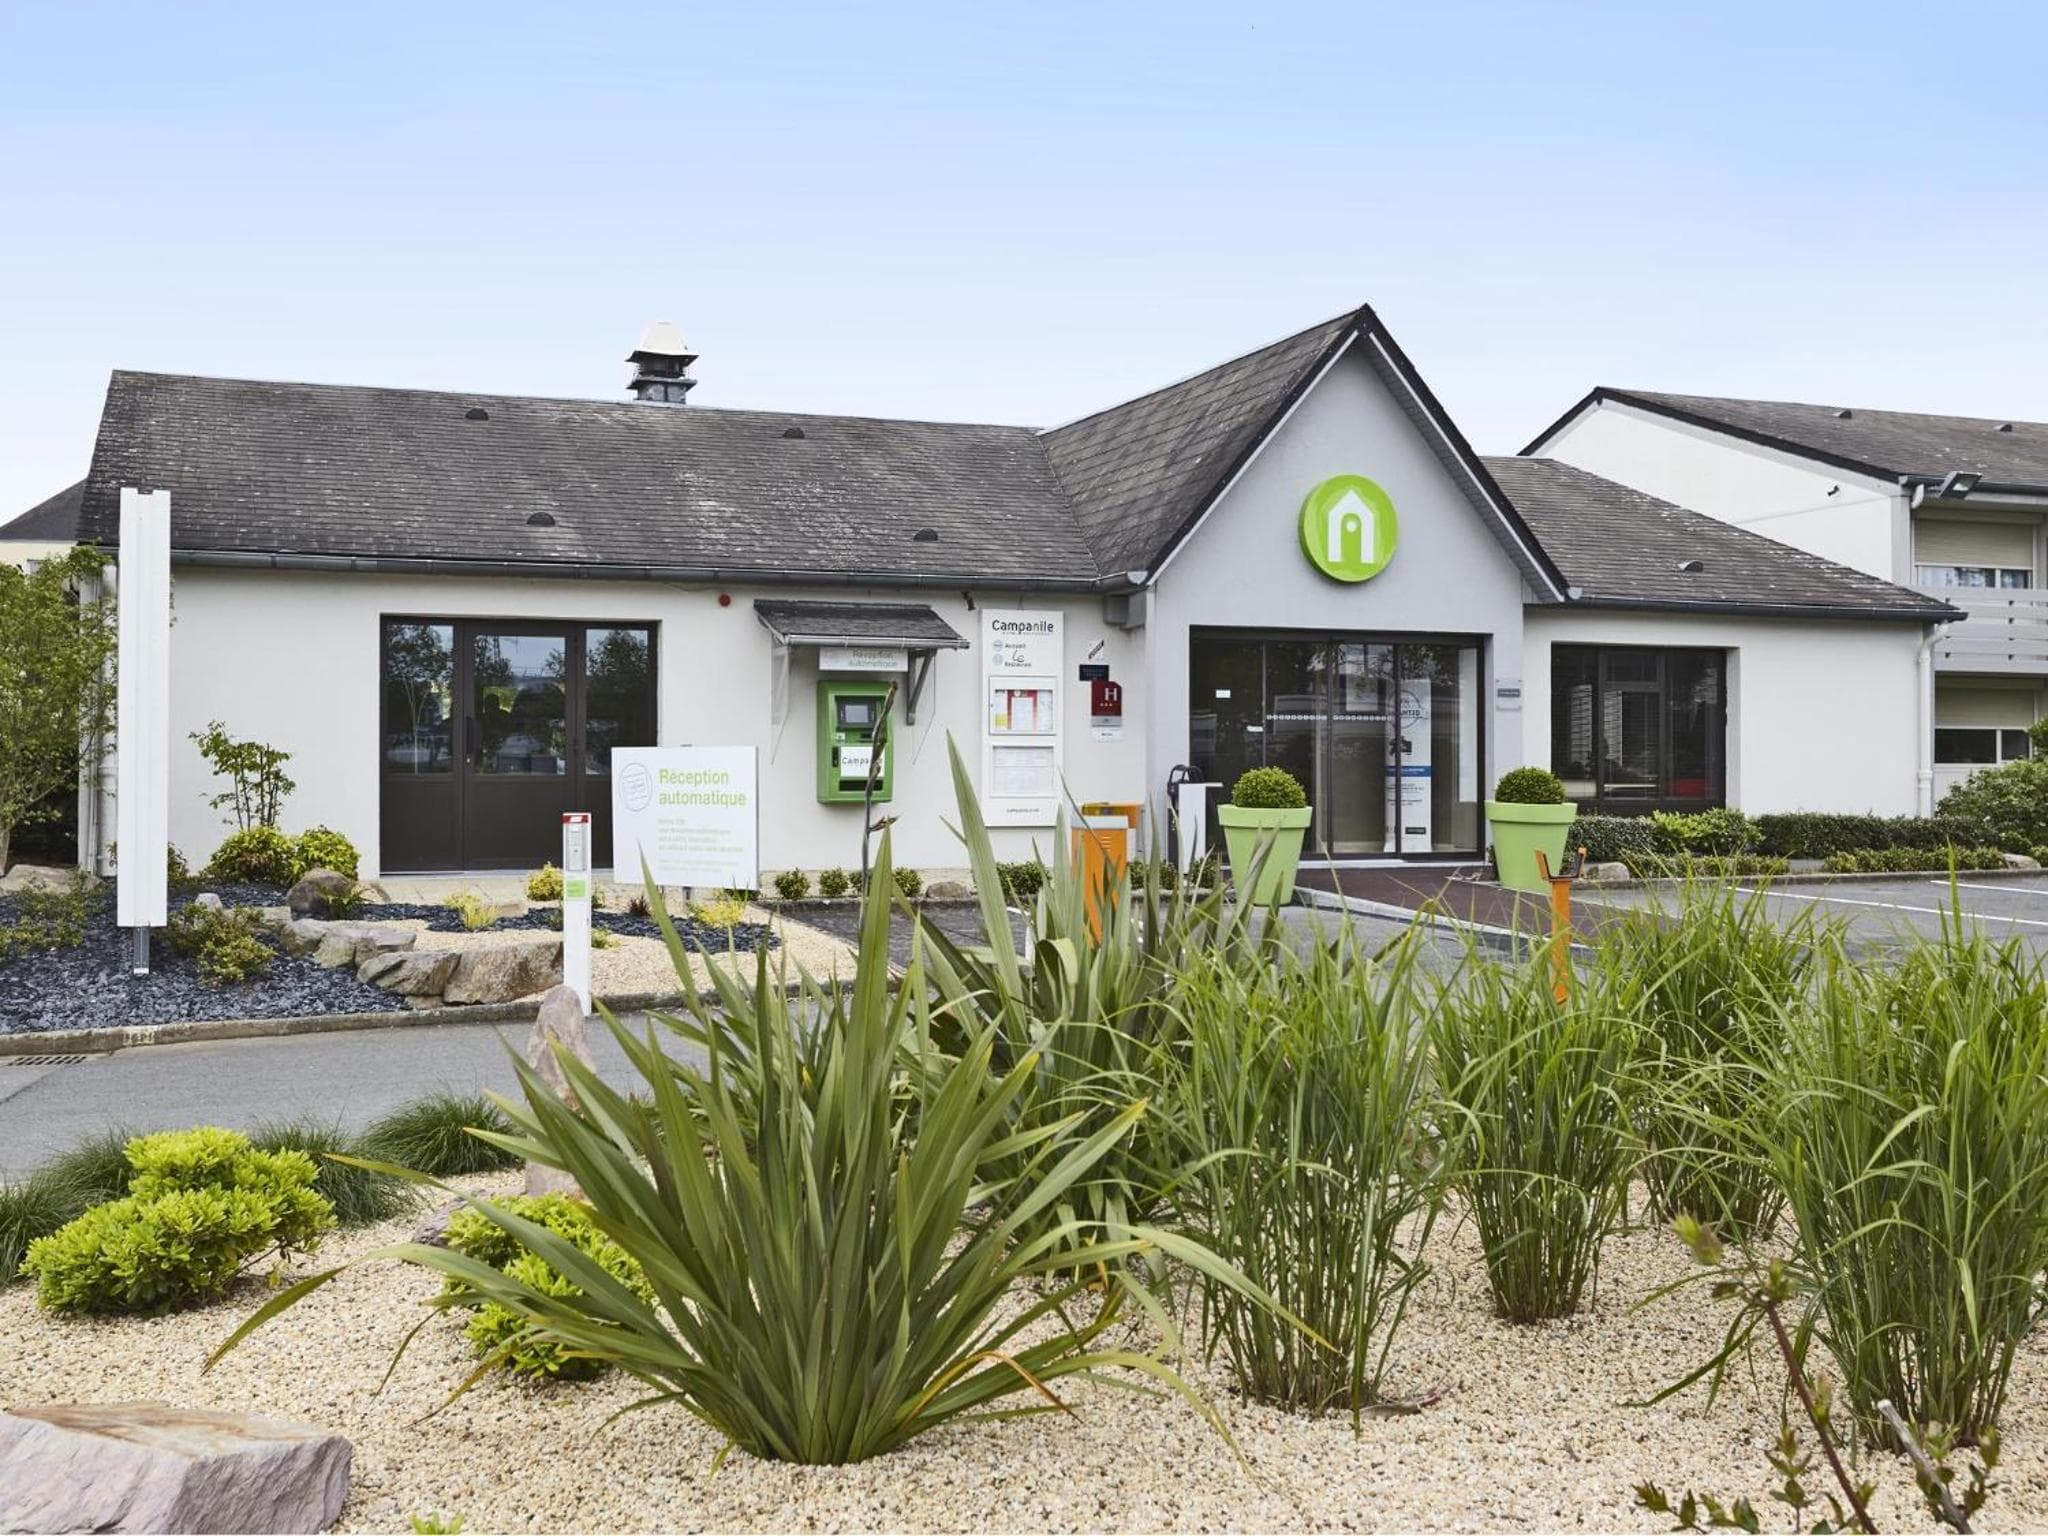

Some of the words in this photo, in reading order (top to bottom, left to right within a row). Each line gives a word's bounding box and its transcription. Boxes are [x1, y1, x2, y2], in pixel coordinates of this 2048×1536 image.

[992, 619, 1054, 635] Campanile
[1104, 687, 1118, 701] H
[659, 791, 748, 808] automatique
